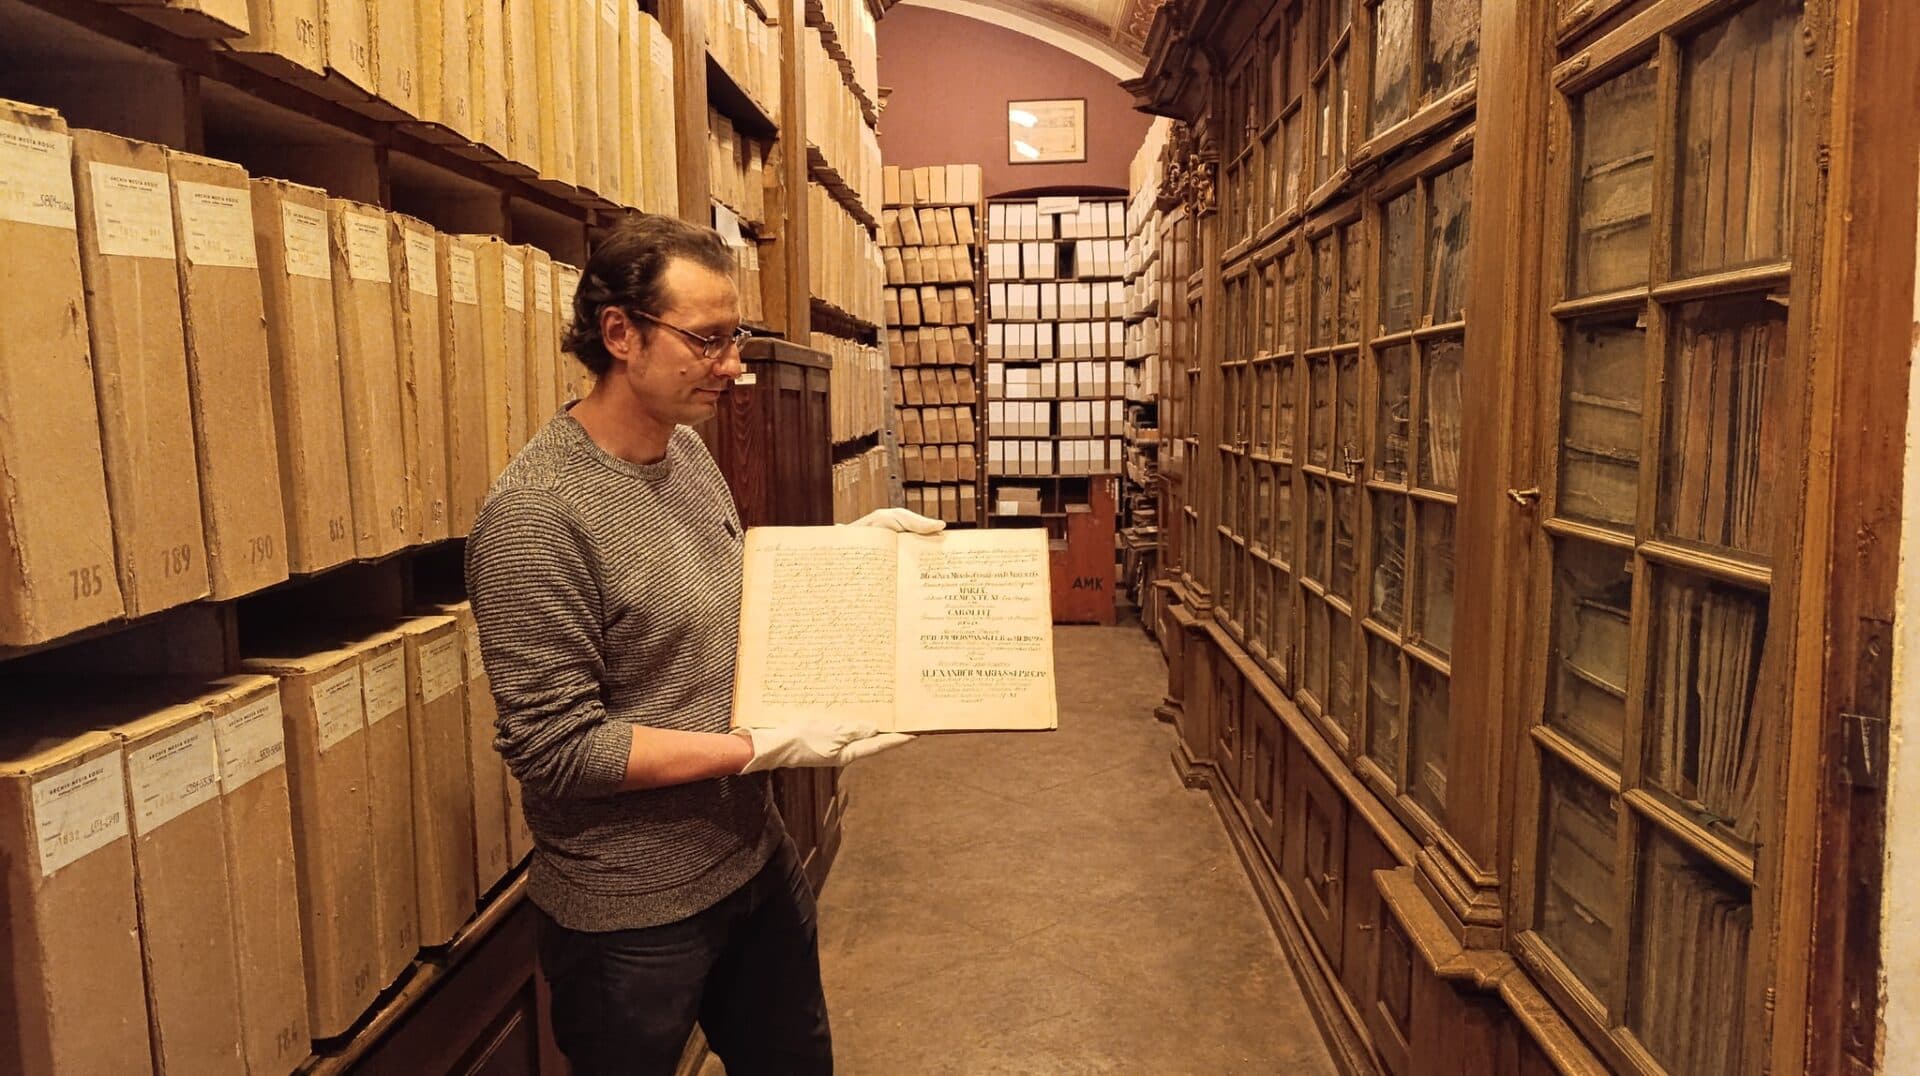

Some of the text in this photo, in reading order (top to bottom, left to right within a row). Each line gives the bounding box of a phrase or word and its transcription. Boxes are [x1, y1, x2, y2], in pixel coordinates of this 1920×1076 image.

[161, 543, 192, 578] 789
[248, 535, 273, 565] 790
[69, 563, 103, 601] 785
[1071, 575, 1104, 592] AMK
